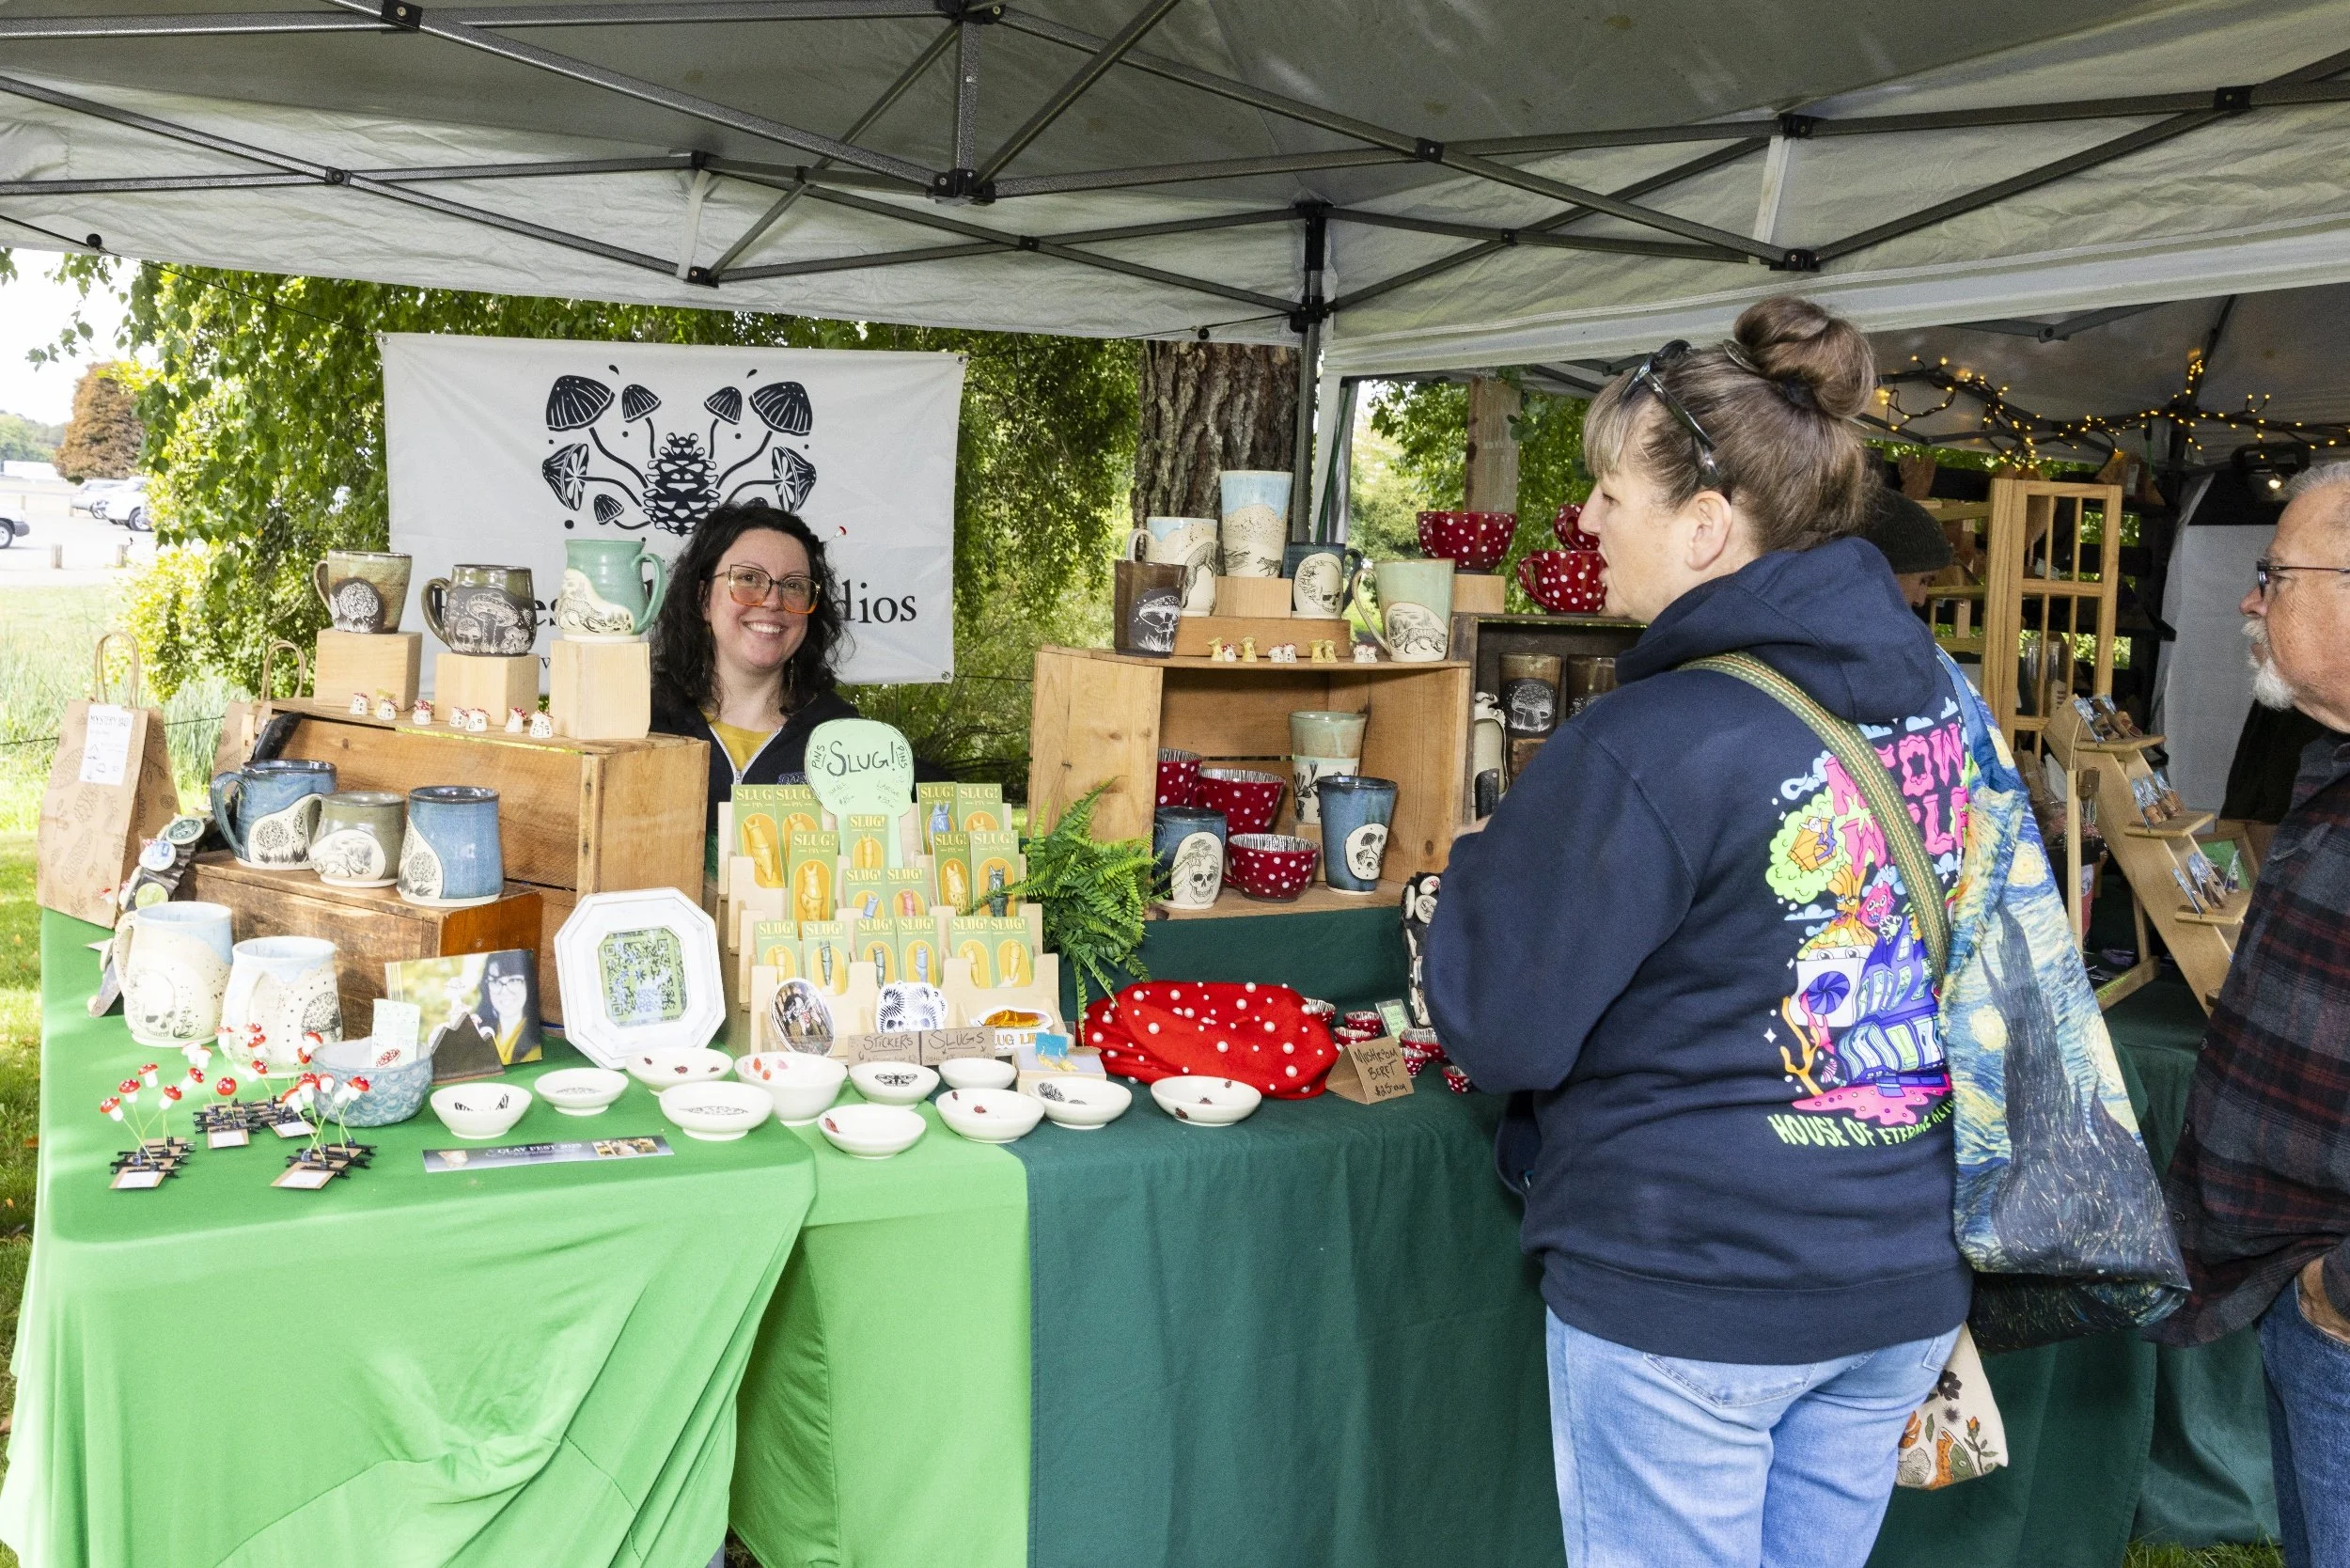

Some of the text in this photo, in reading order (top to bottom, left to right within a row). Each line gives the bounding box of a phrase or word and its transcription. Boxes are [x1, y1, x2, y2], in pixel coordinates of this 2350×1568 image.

[833, 579, 916, 624] dios
[812, 745, 825, 770] PINS
[827, 740, 896, 776] SLUG!
[897, 745, 908, 769] PINS
[1824, 723, 1963, 816] MOW
[736, 789, 773, 801] SLUG
[776, 789, 816, 801] SLUG
[920, 786, 954, 798] SLUG!
[960, 787, 998, 799] SLUG!
[850, 815, 885, 827] SLUG!
[793, 834, 835, 846] SLUG!
[935, 834, 966, 846] SLUG!
[974, 833, 1014, 845] SLUG!
[846, 870, 882, 882] SLUG!
[886, 868, 923, 881] SLUG!
[759, 921, 794, 935] SLUG!
[806, 922, 843, 935] SLUG!
[858, 917, 893, 932] SLUG!
[901, 917, 934, 931] SLUG!
[953, 917, 987, 931] SLUG!
[991, 917, 1026, 931] SLUG!
[863, 1034, 914, 1051] STICKERS
[995, 1034, 1015, 1046] UG
[1367, 1058, 1398, 1081] BERET
[1767, 1113, 1850, 1147] HOUSE
[1841, 1116, 1876, 1147] OF
[497, 1146, 526, 1154] CLAY
